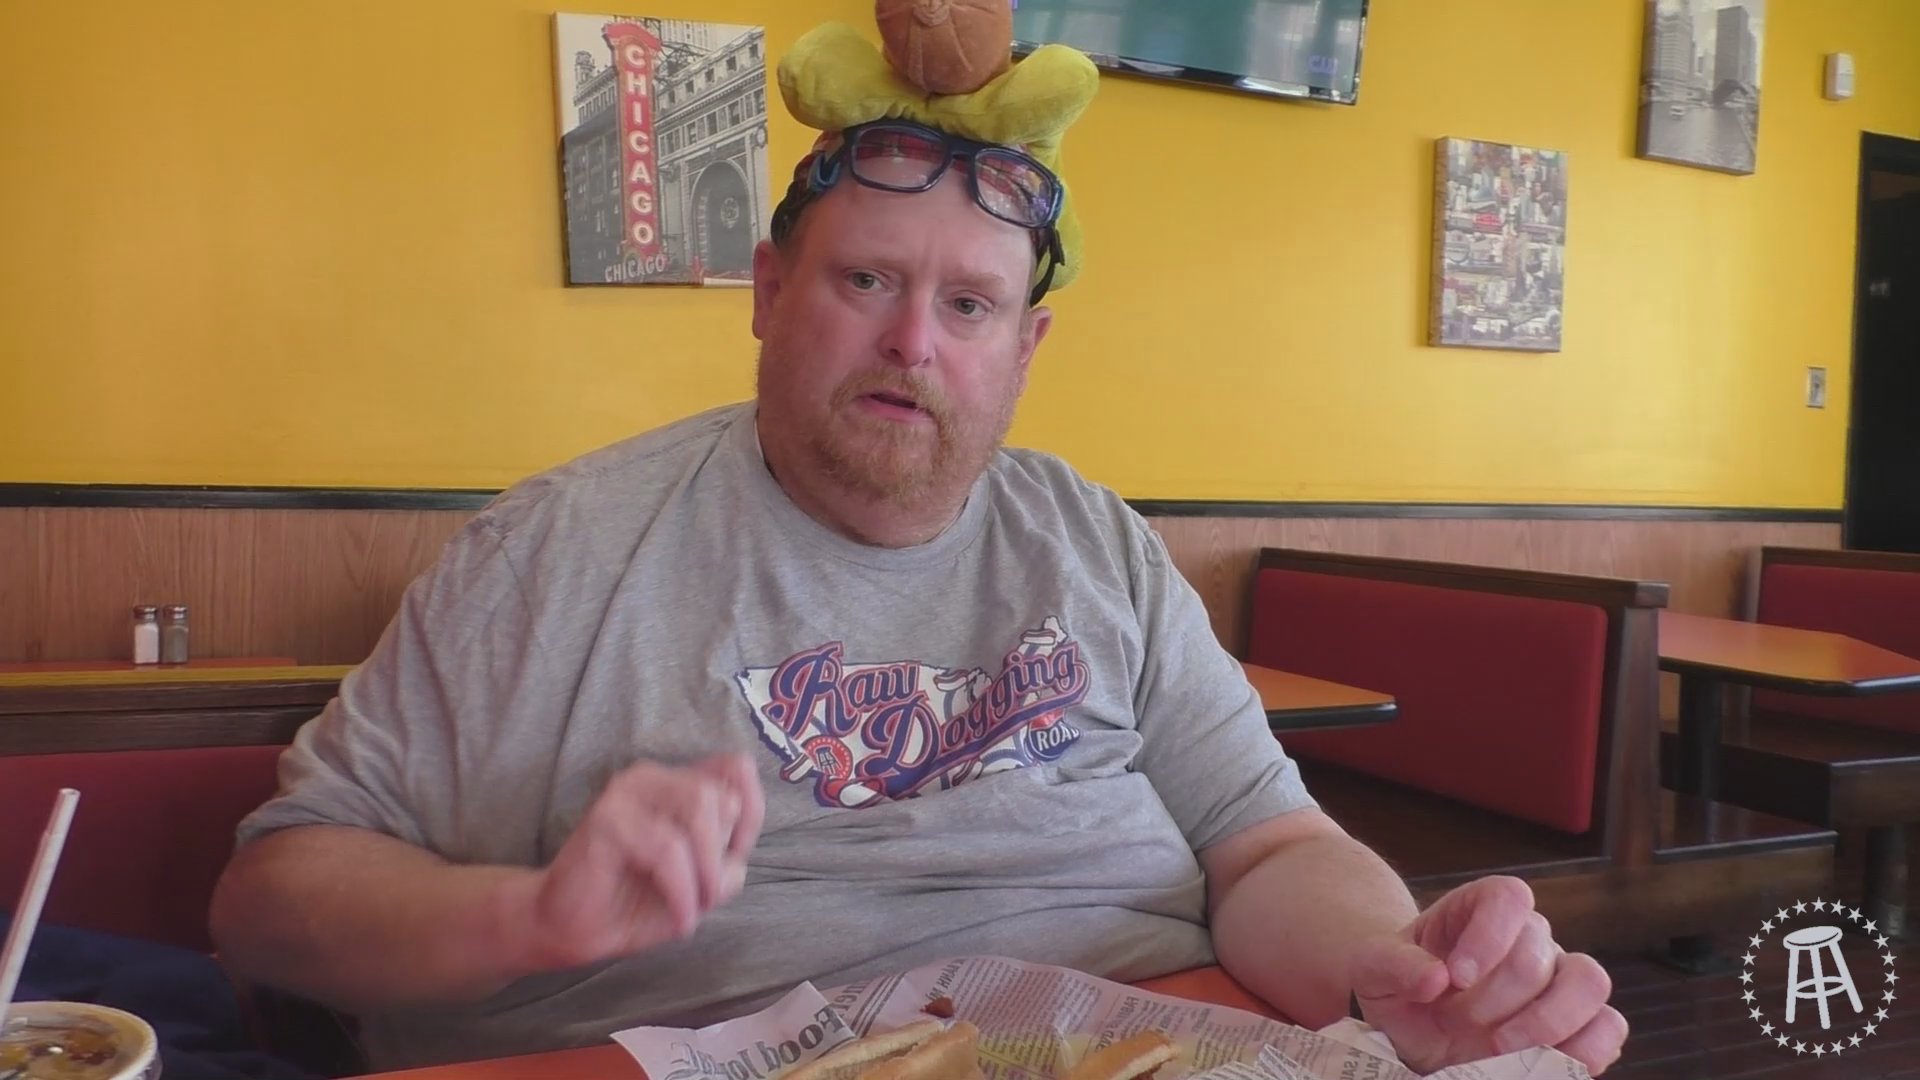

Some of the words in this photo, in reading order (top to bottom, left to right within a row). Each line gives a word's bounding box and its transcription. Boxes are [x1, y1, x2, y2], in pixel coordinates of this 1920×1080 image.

[625, 44, 654, 244] CHICAGO
[604, 253, 666, 283] CHICAGO
[761, 640, 921, 739] Raw
[855, 641, 1091, 780] Dogging
